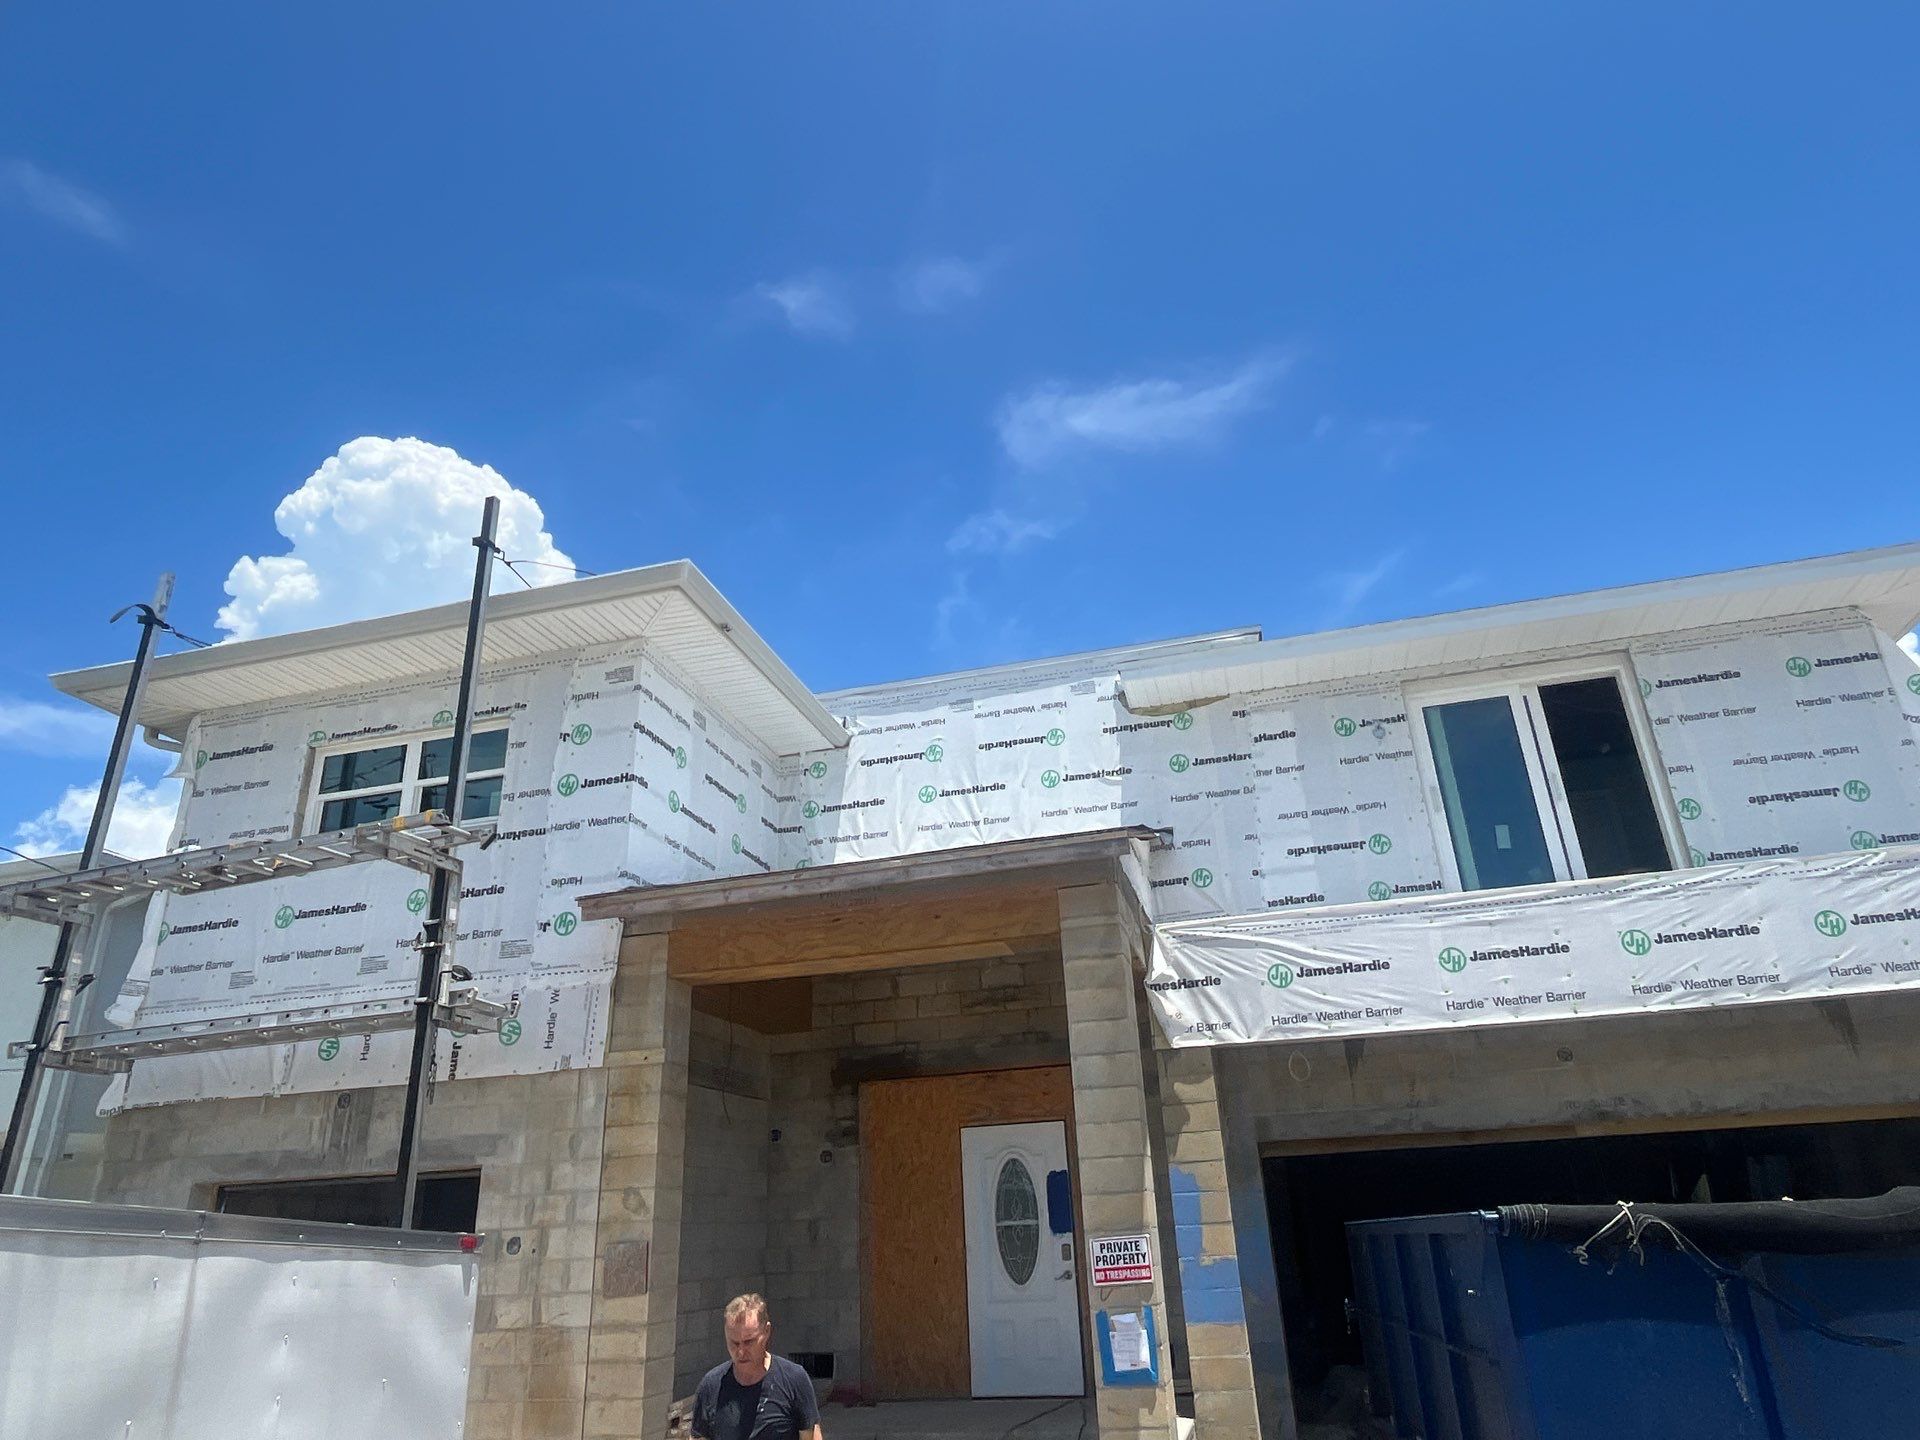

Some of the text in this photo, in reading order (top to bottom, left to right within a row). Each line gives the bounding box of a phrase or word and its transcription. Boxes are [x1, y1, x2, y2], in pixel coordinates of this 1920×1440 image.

[1656, 670, 1741, 688] JamesHardie
[1103, 720, 1172, 735] JamesHardie
[978, 735, 1047, 751] JamesHardie
[861, 751, 925, 767] JamesHardie
[580, 772, 648, 789] JamesHardie
[1062, 767, 1132, 782] JamesHardie
[939, 782, 1006, 798] JamesHardie
[1749, 787, 1840, 805] JamesHardie
[821, 798, 885, 814] JamesHardie
[1287, 840, 1366, 857] JamesHardie
[1707, 844, 1799, 862] JamesHardie
[295, 902, 367, 920] JamesHardie
[170, 918, 239, 935] JamesHardie
[1654, 924, 1760, 944] JamesHardie
[1470, 943, 1570, 962] JamesHardie
[1297, 960, 1390, 978] JamesHardie
[1680, 977, 1733, 990] Weather
[1738, 973, 1781, 986] Barrier
[1492, 994, 1542, 1006] Weather
[1546, 990, 1586, 1002] Barrier
[1316, 1010, 1362, 1023] Weather
[1366, 1006, 1403, 1018] Barrier
[1100, 1240, 1140, 1254] PRIVATE
[1096, 1252, 1147, 1266] PROPERTY
[1096, 1268, 1150, 1281] NO TRESPASSING
